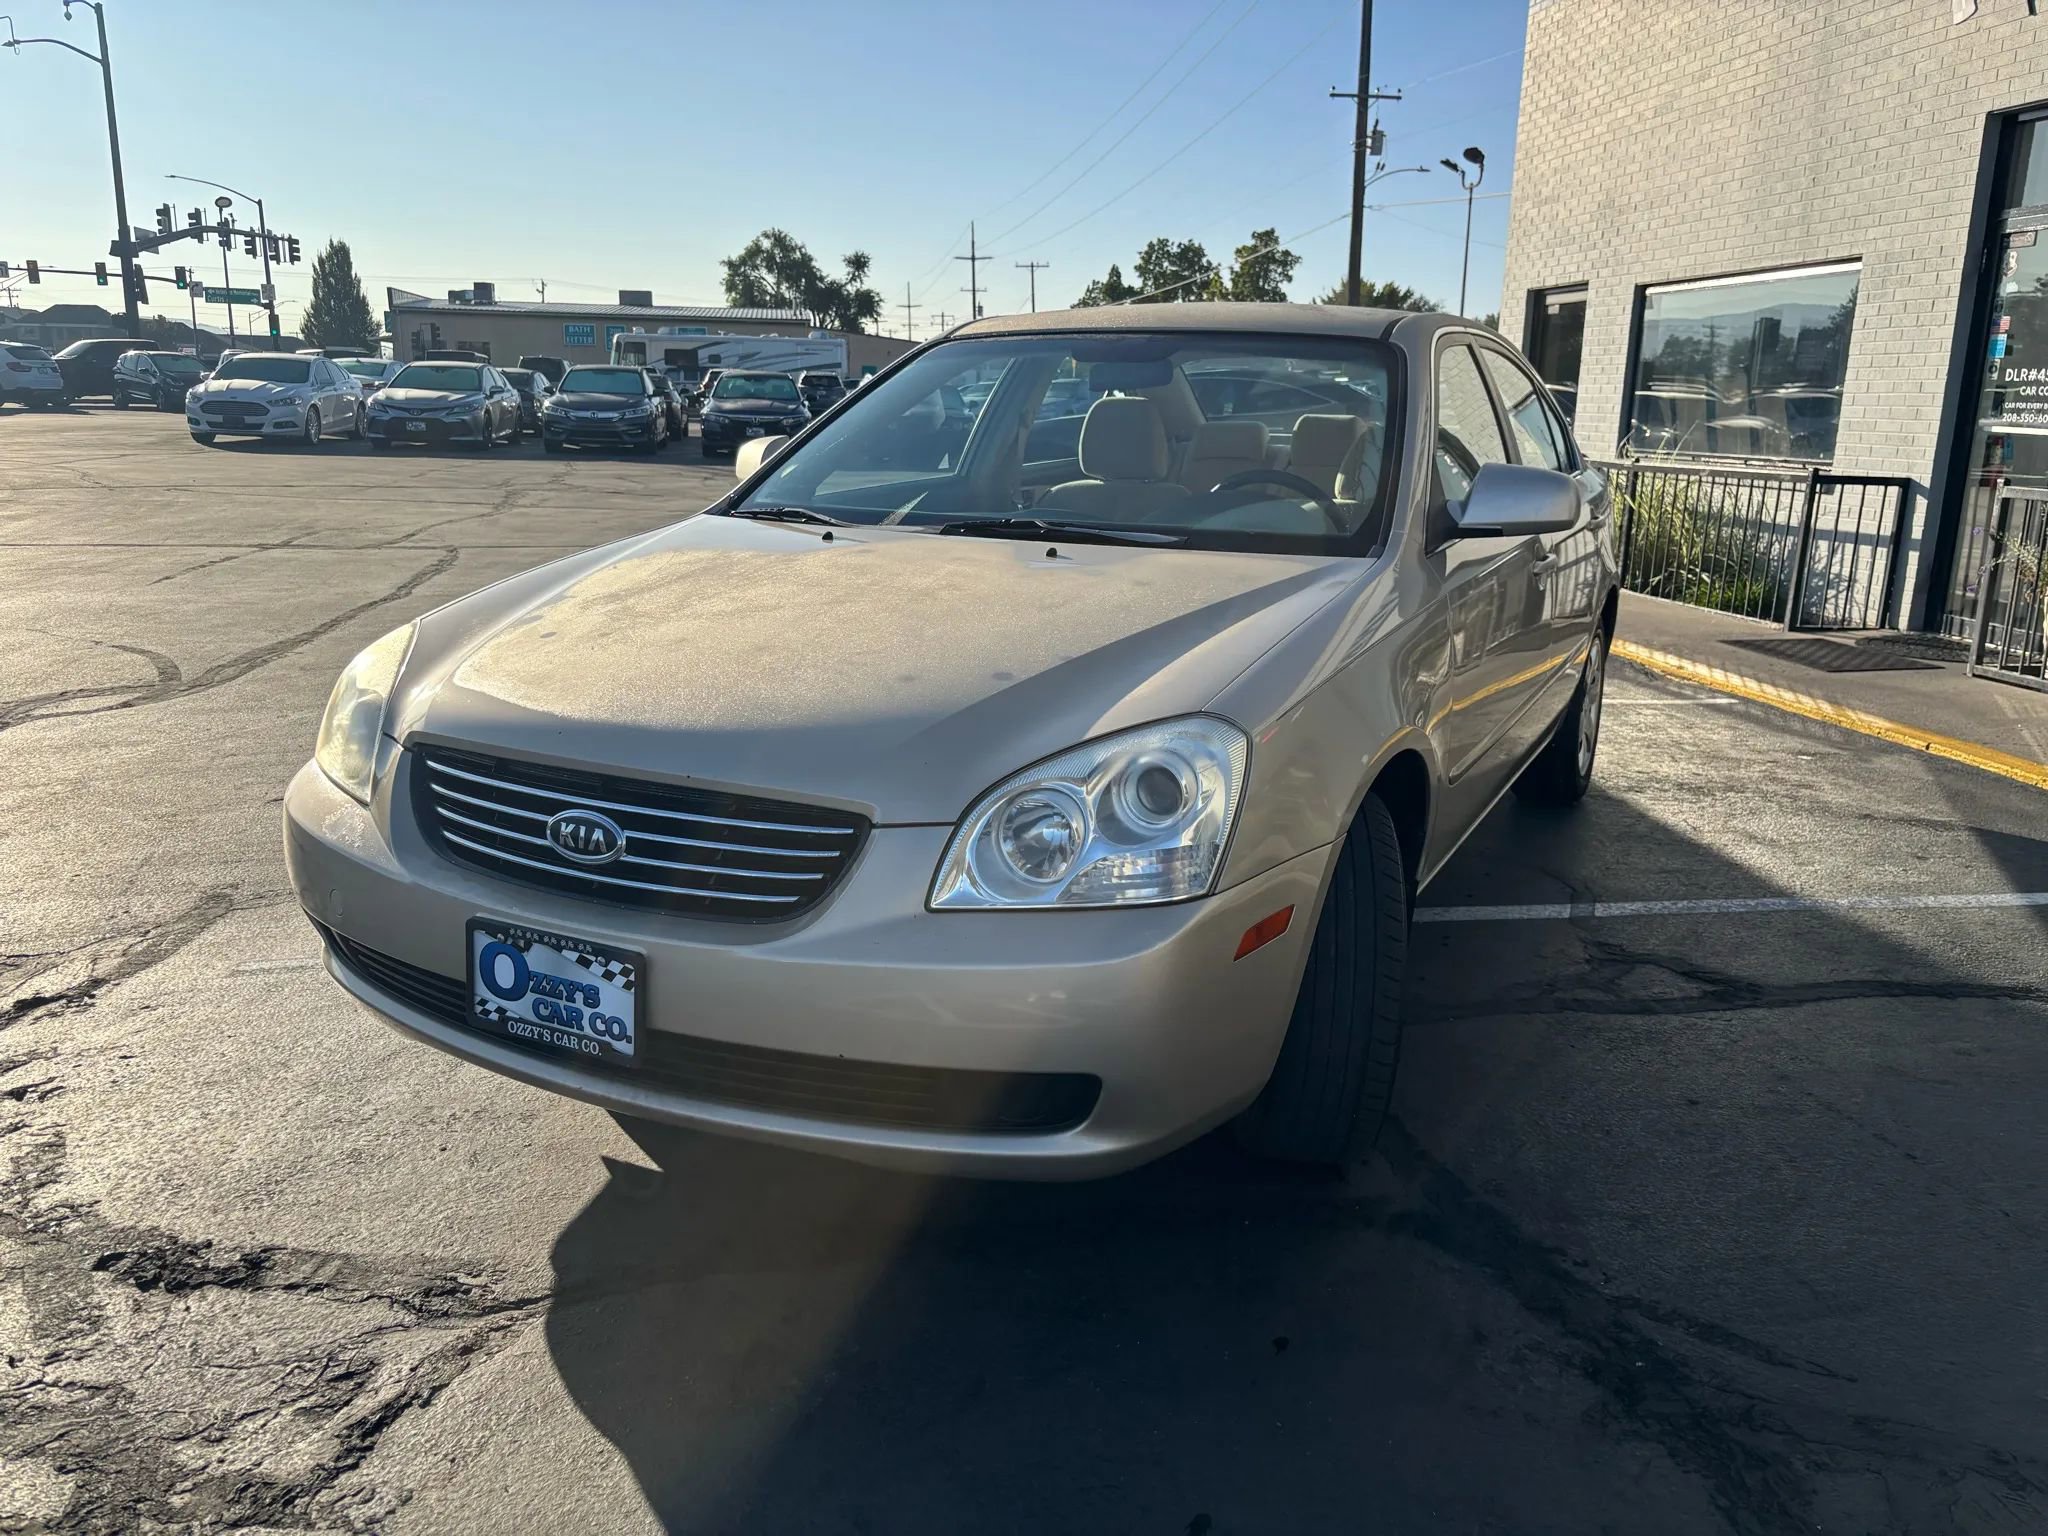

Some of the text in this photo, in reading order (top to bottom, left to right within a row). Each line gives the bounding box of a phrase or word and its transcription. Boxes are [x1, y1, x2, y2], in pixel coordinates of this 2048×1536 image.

[2020, 386, 2037, 396] CAR
[2027, 402, 2043, 410] EVERY
[559, 821, 608, 853] KIA
[479, 941, 601, 1009] OZZY'S
[531, 997, 633, 1044] CAR CO.
[507, 1020, 602, 1056] OZZY'S CAR CO.
